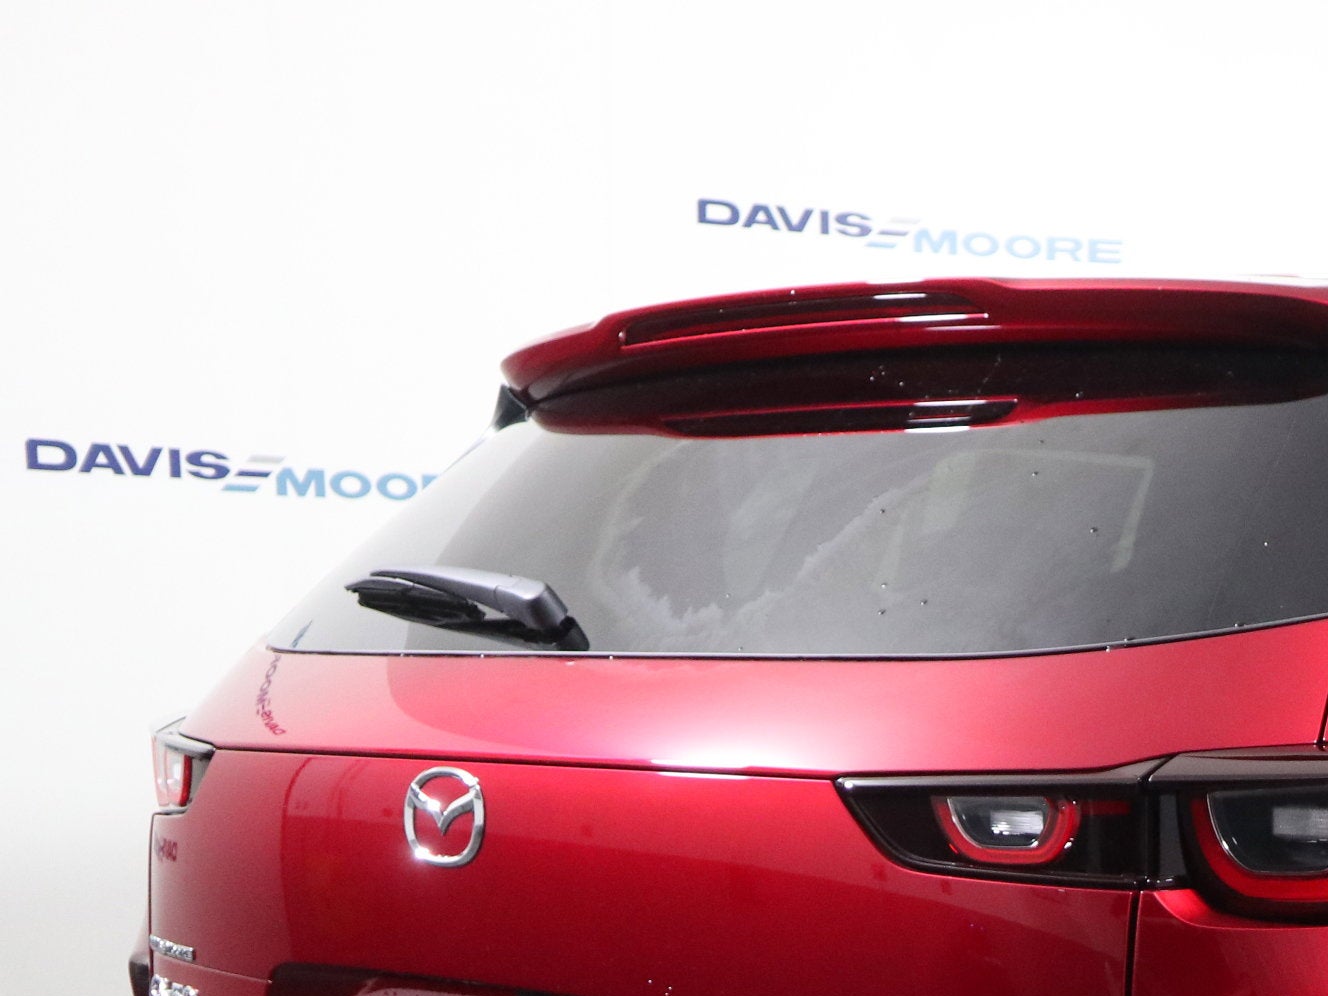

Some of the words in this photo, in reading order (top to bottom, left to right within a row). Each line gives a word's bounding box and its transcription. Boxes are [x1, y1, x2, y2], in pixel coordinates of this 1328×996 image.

[697, 197, 873, 237] DAVIS
[913, 227, 1123, 264] MOORE
[25, 437, 231, 480] DAVIS
